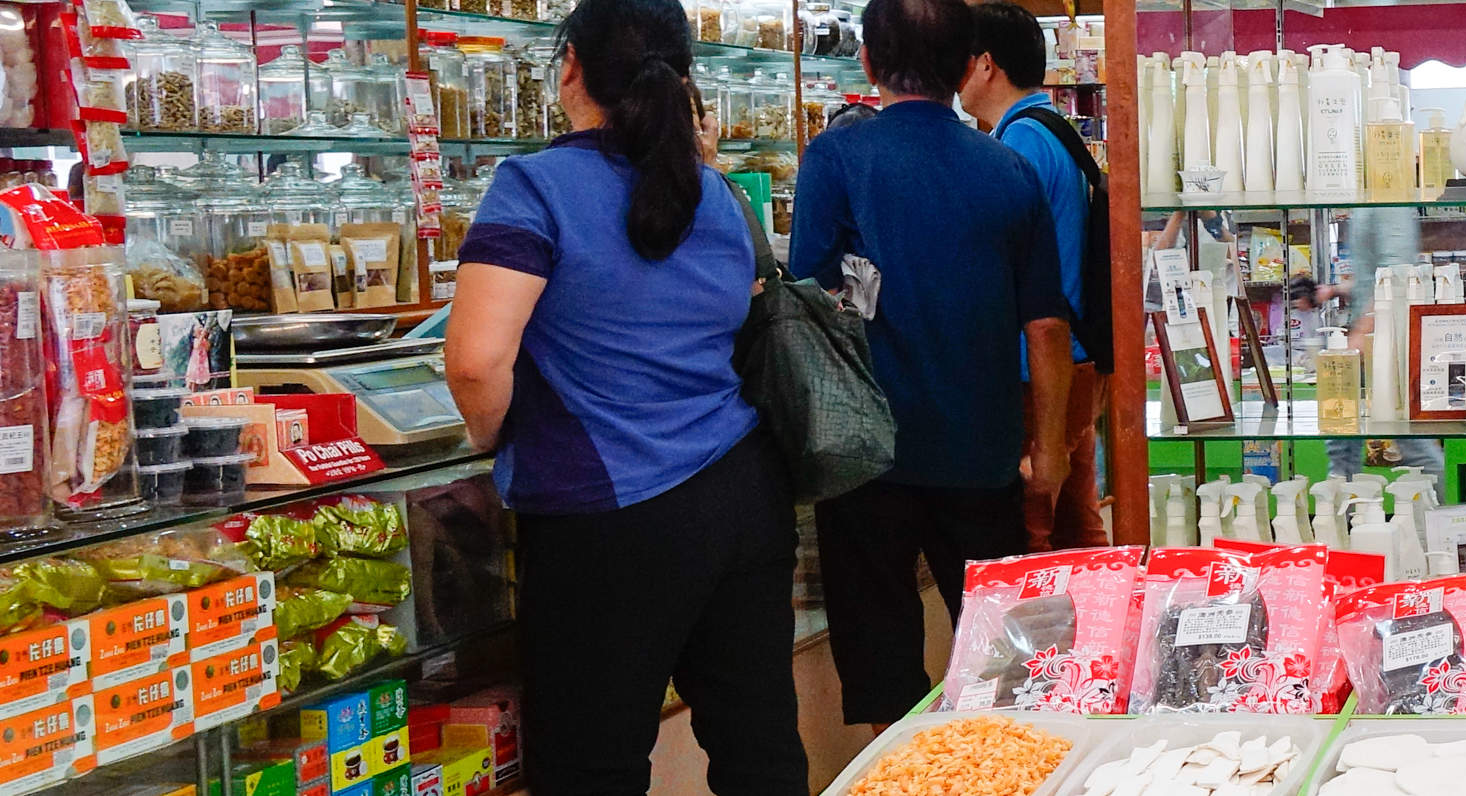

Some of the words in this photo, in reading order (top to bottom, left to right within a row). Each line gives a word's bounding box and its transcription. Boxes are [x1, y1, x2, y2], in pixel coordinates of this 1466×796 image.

[296, 449, 317, 463] Po
[312, 443, 343, 460] Chai
[336, 439, 366, 456] Pills
[1027, 567, 1060, 589] 新
